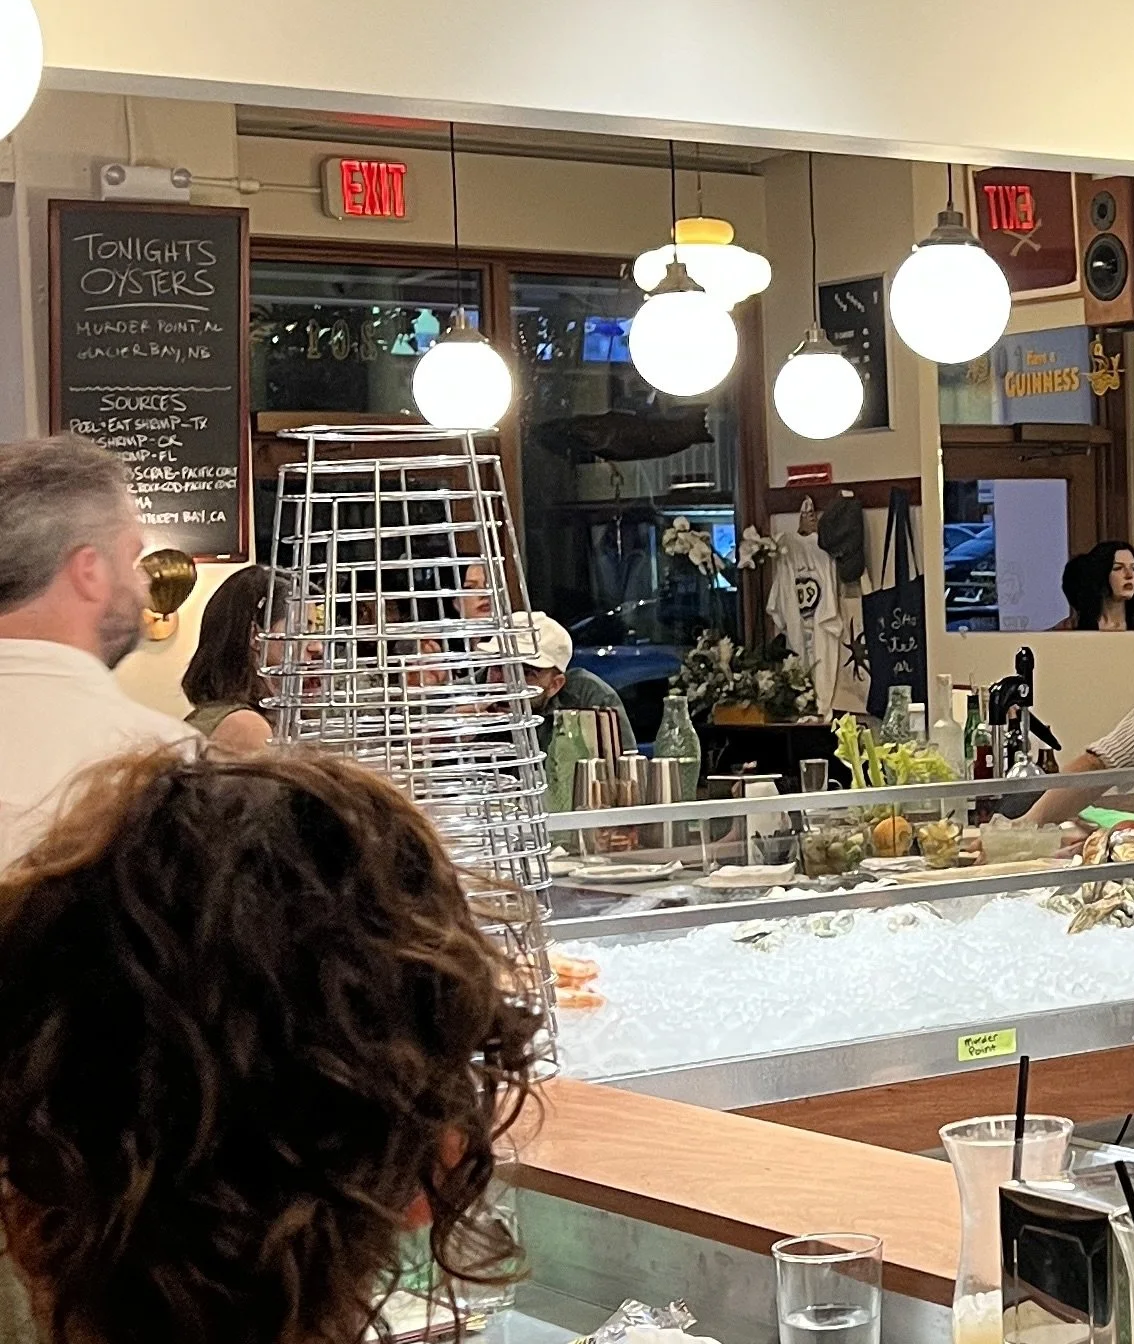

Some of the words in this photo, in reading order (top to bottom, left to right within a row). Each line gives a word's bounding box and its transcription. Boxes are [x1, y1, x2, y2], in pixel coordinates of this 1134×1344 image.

[341, 159, 407, 218] EXIT
[72, 232, 217, 266] TONIGHTS
[80, 263, 216, 297] OYSTERS
[75, 319, 150, 337] MURDER
[1004, 366, 1080, 399] GUINNESS
[99, 393, 187, 413] SOURCES
